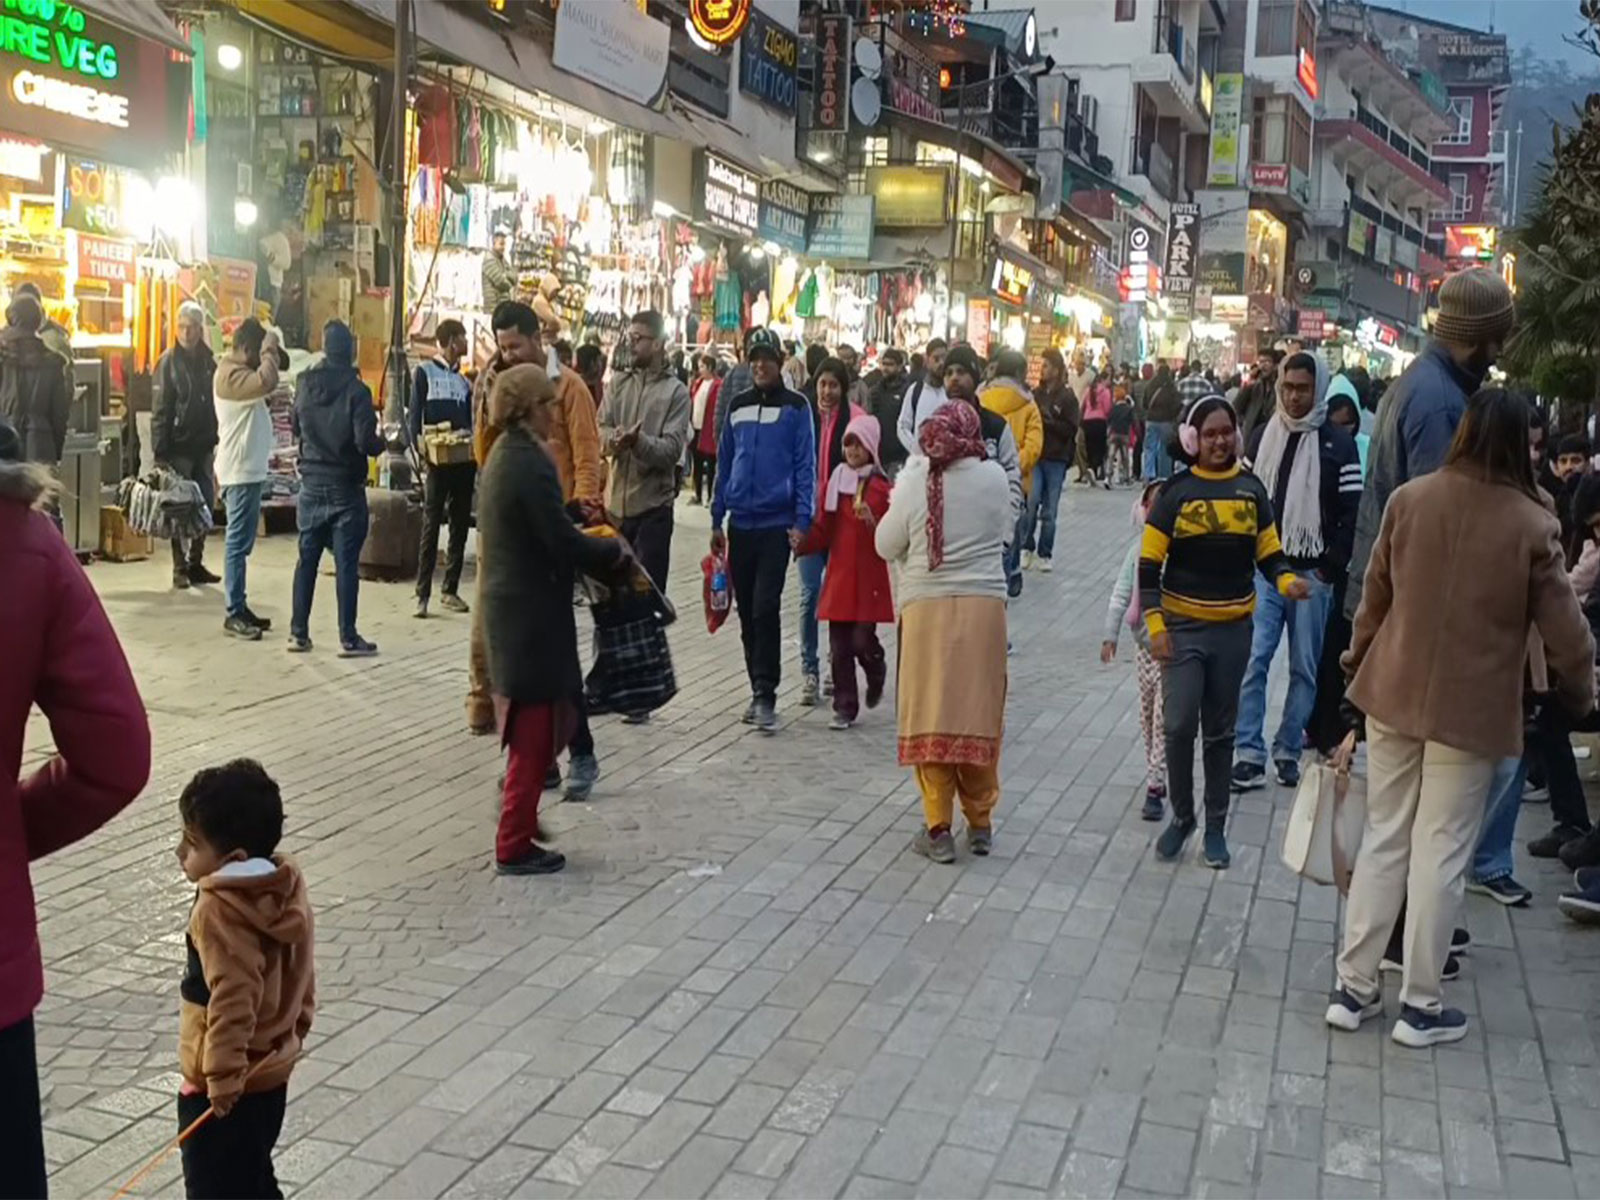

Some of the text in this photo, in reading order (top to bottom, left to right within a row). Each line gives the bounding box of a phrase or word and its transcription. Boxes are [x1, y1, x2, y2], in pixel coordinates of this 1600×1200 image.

[55, 31, 117, 78] VEG
[820, 20, 838, 126] TATTOO
[748, 53, 794, 107] TATTOO
[1171, 203, 1199, 215] HOTEL
[1169, 214, 1195, 276] PARK
[1164, 276, 1192, 292] VIEW
